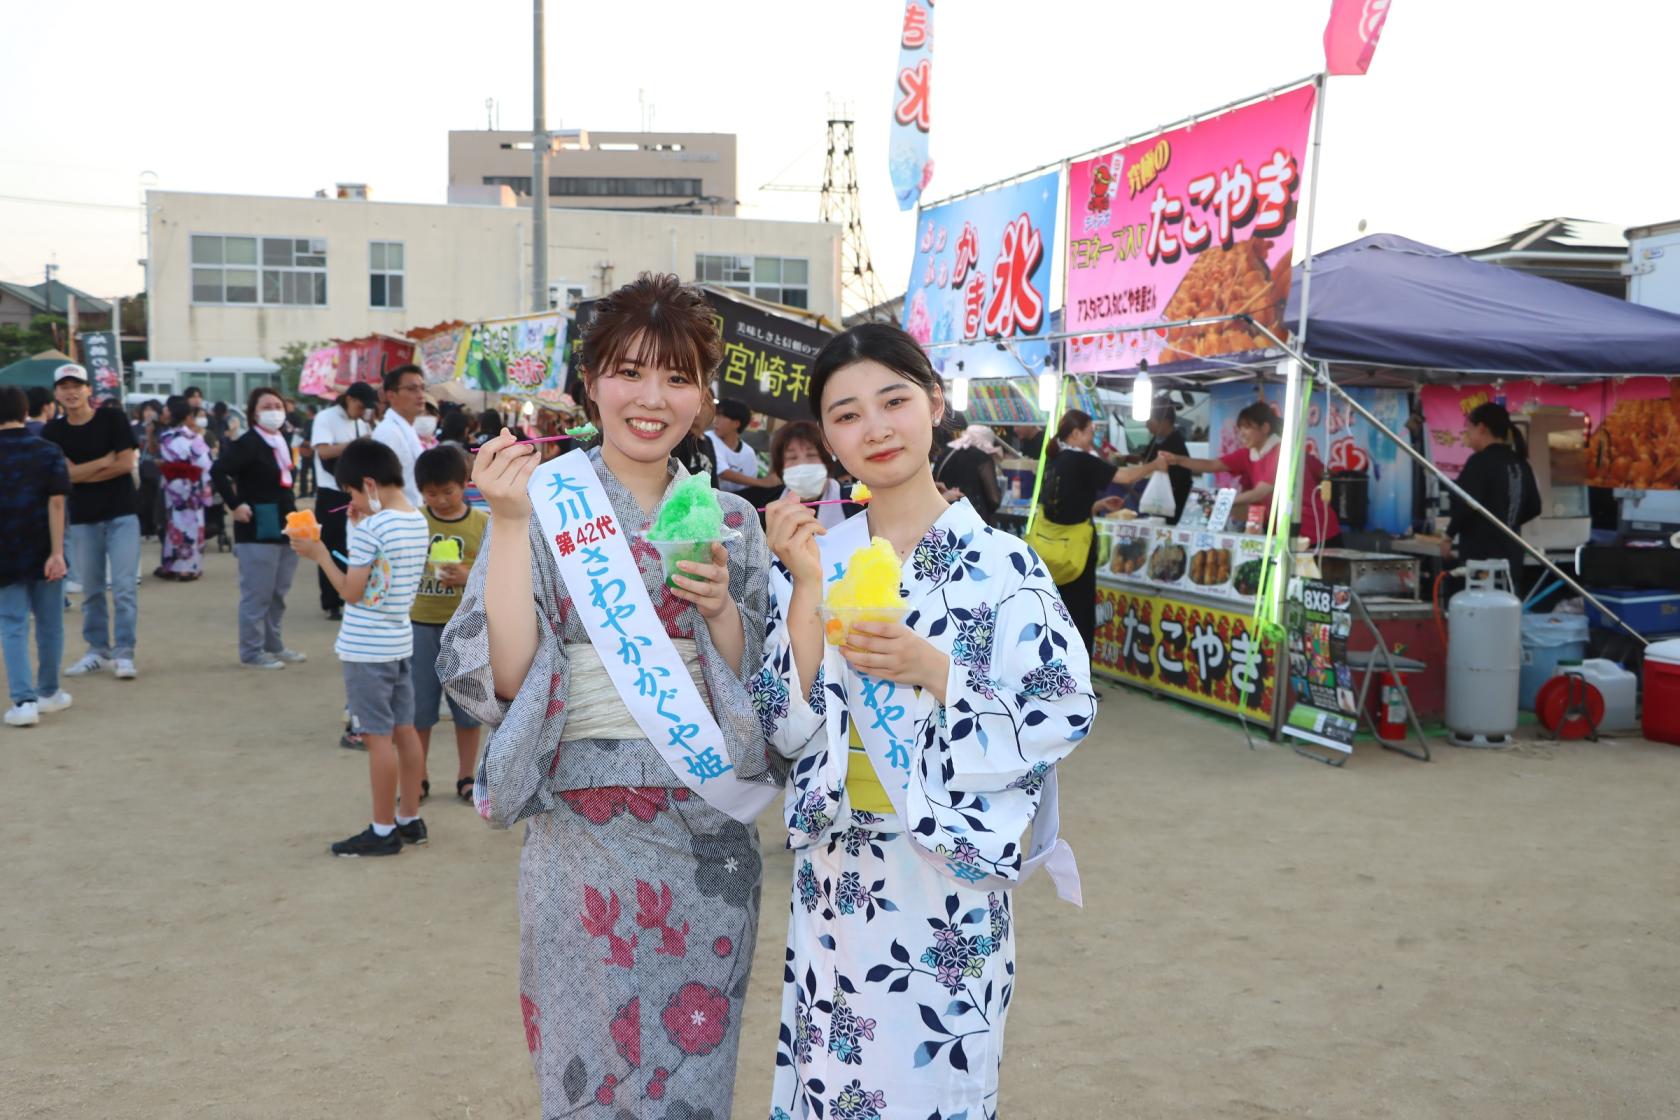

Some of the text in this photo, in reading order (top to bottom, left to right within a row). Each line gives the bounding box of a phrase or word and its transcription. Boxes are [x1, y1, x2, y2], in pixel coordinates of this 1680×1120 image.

[1070, 223, 1147, 269] マヨネーズ入り
[1146, 148, 1298, 264] たこやき
[952, 212, 1043, 340] かき氷
[547, 472, 597, 530] 大川
[554, 514, 617, 558] 第42代
[580, 544, 735, 785] さわやかかぐや姫
[1122, 608, 1263, 695] たこやき
